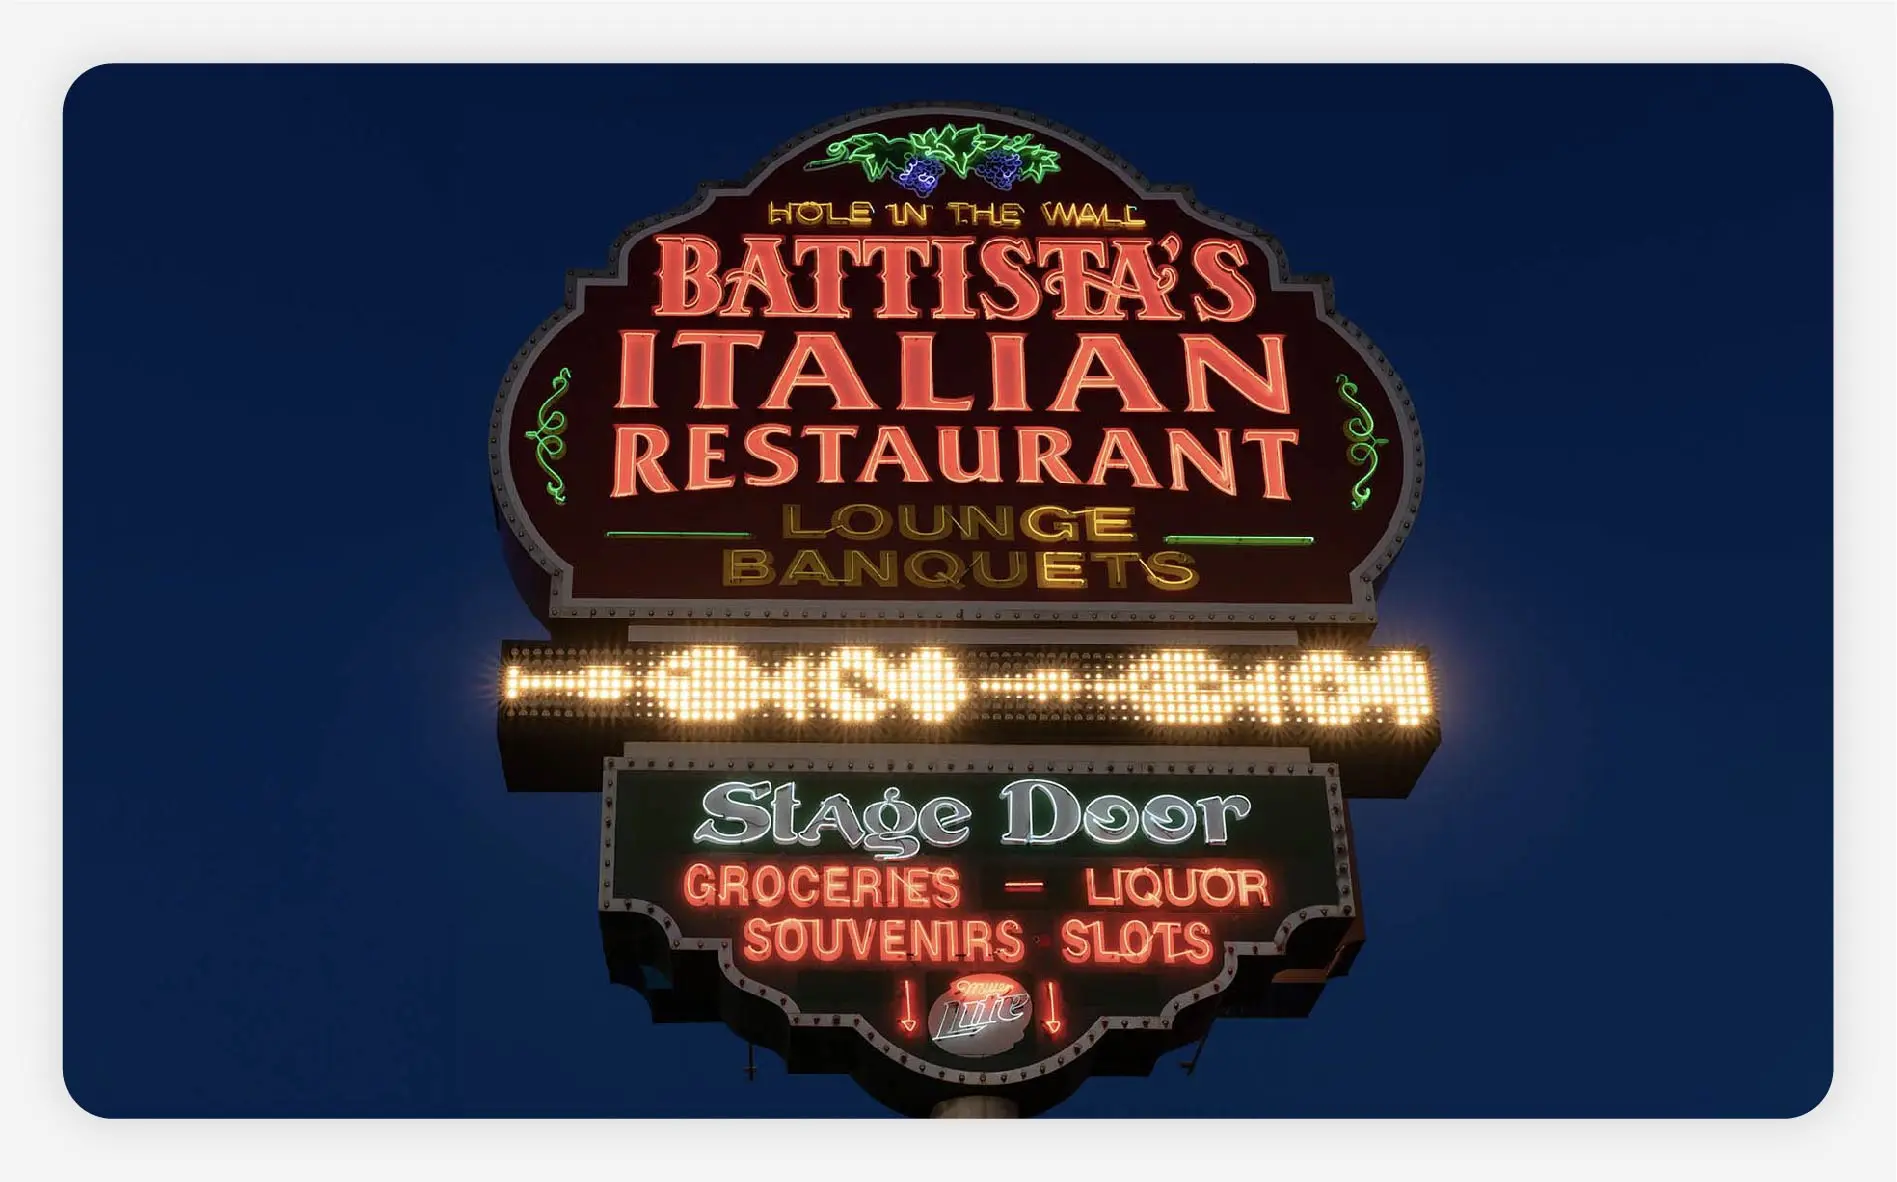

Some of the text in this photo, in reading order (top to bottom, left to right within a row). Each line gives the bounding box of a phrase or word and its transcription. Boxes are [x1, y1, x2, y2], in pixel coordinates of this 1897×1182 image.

[768, 201, 1146, 228] HOLE IN THE WALL
[652, 234, 1257, 322] BATTISTA'S
[614, 329, 1292, 415] ITALIAN
[610, 422, 1299, 500] RESTAURANT
[782, 504, 1137, 540] LOUNGE
[722, 548, 1200, 590] BANQUETS
[999, 778, 1252, 846] Door
[683, 863, 962, 908] GROCERIES
[1085, 867, 1271, 907] LIQUOR
[743, 916, 1214, 965] SOUVENIRS SLOTS
